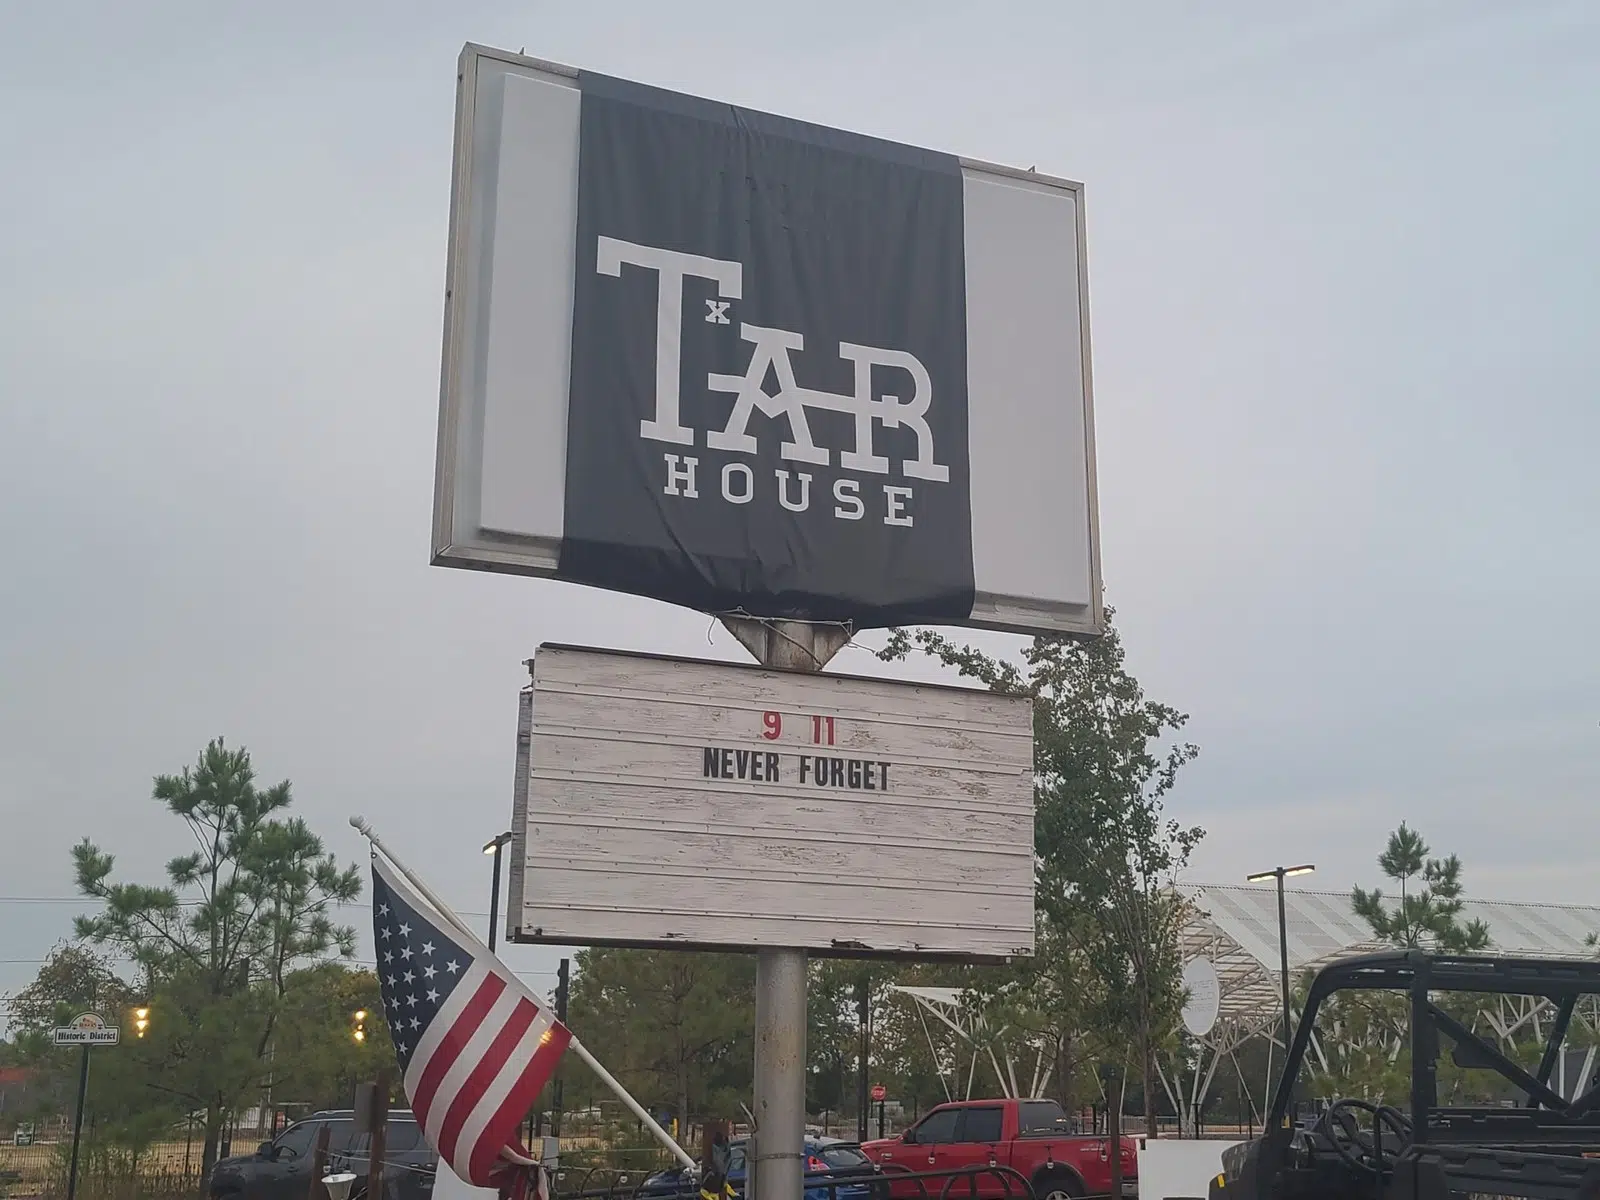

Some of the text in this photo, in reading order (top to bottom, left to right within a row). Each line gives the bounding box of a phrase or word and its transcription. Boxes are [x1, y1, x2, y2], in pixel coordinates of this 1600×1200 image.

[664, 453, 913, 527] HOUSE
[763, 711, 835, 745] 9 11
[703, 748, 892, 791] NEVER FORGET
[58, 1032, 116, 1040] Historic District
